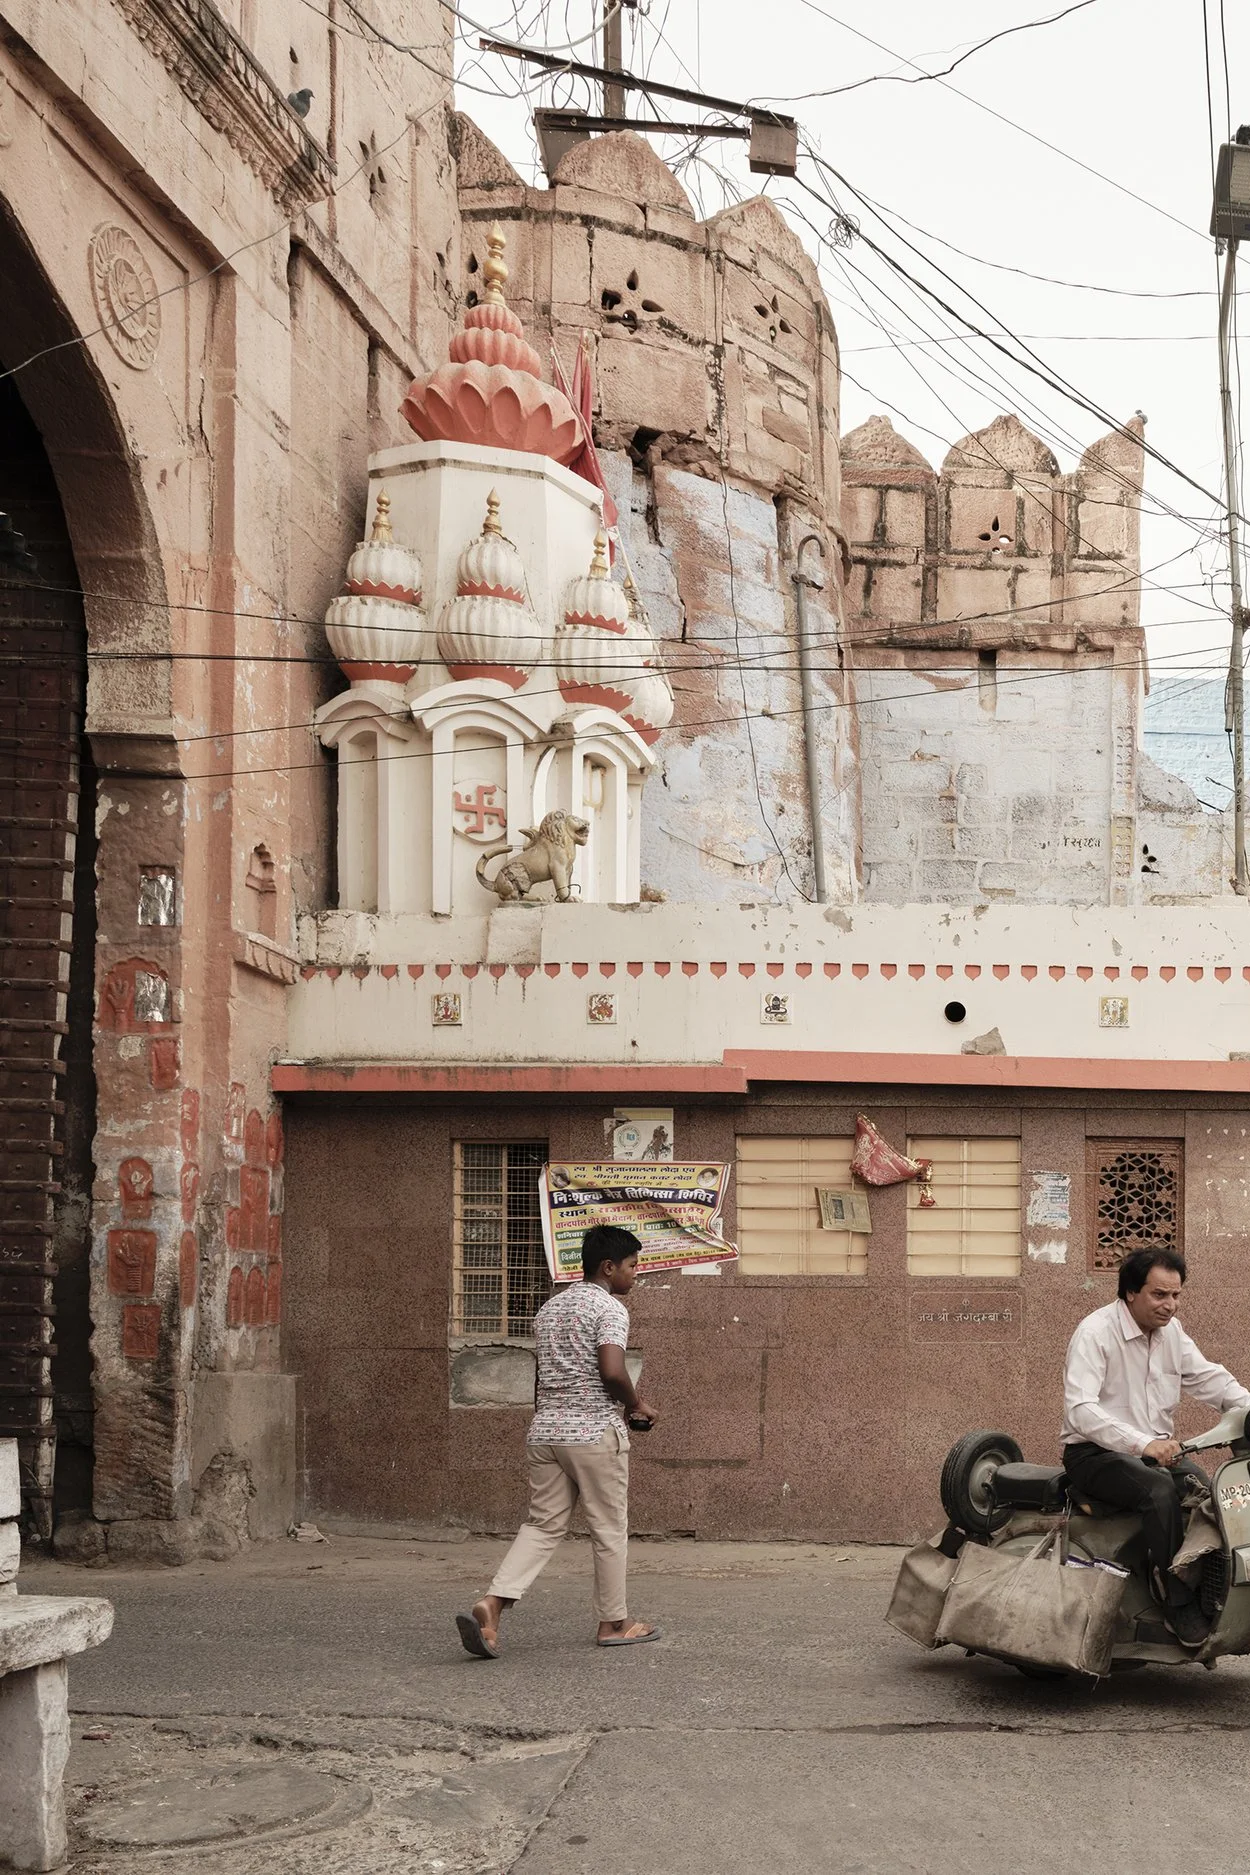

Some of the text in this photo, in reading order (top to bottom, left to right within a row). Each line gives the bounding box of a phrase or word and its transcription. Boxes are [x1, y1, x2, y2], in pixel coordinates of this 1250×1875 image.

[917, 1308, 1013, 1325] जय श्री जगदम्बा री
